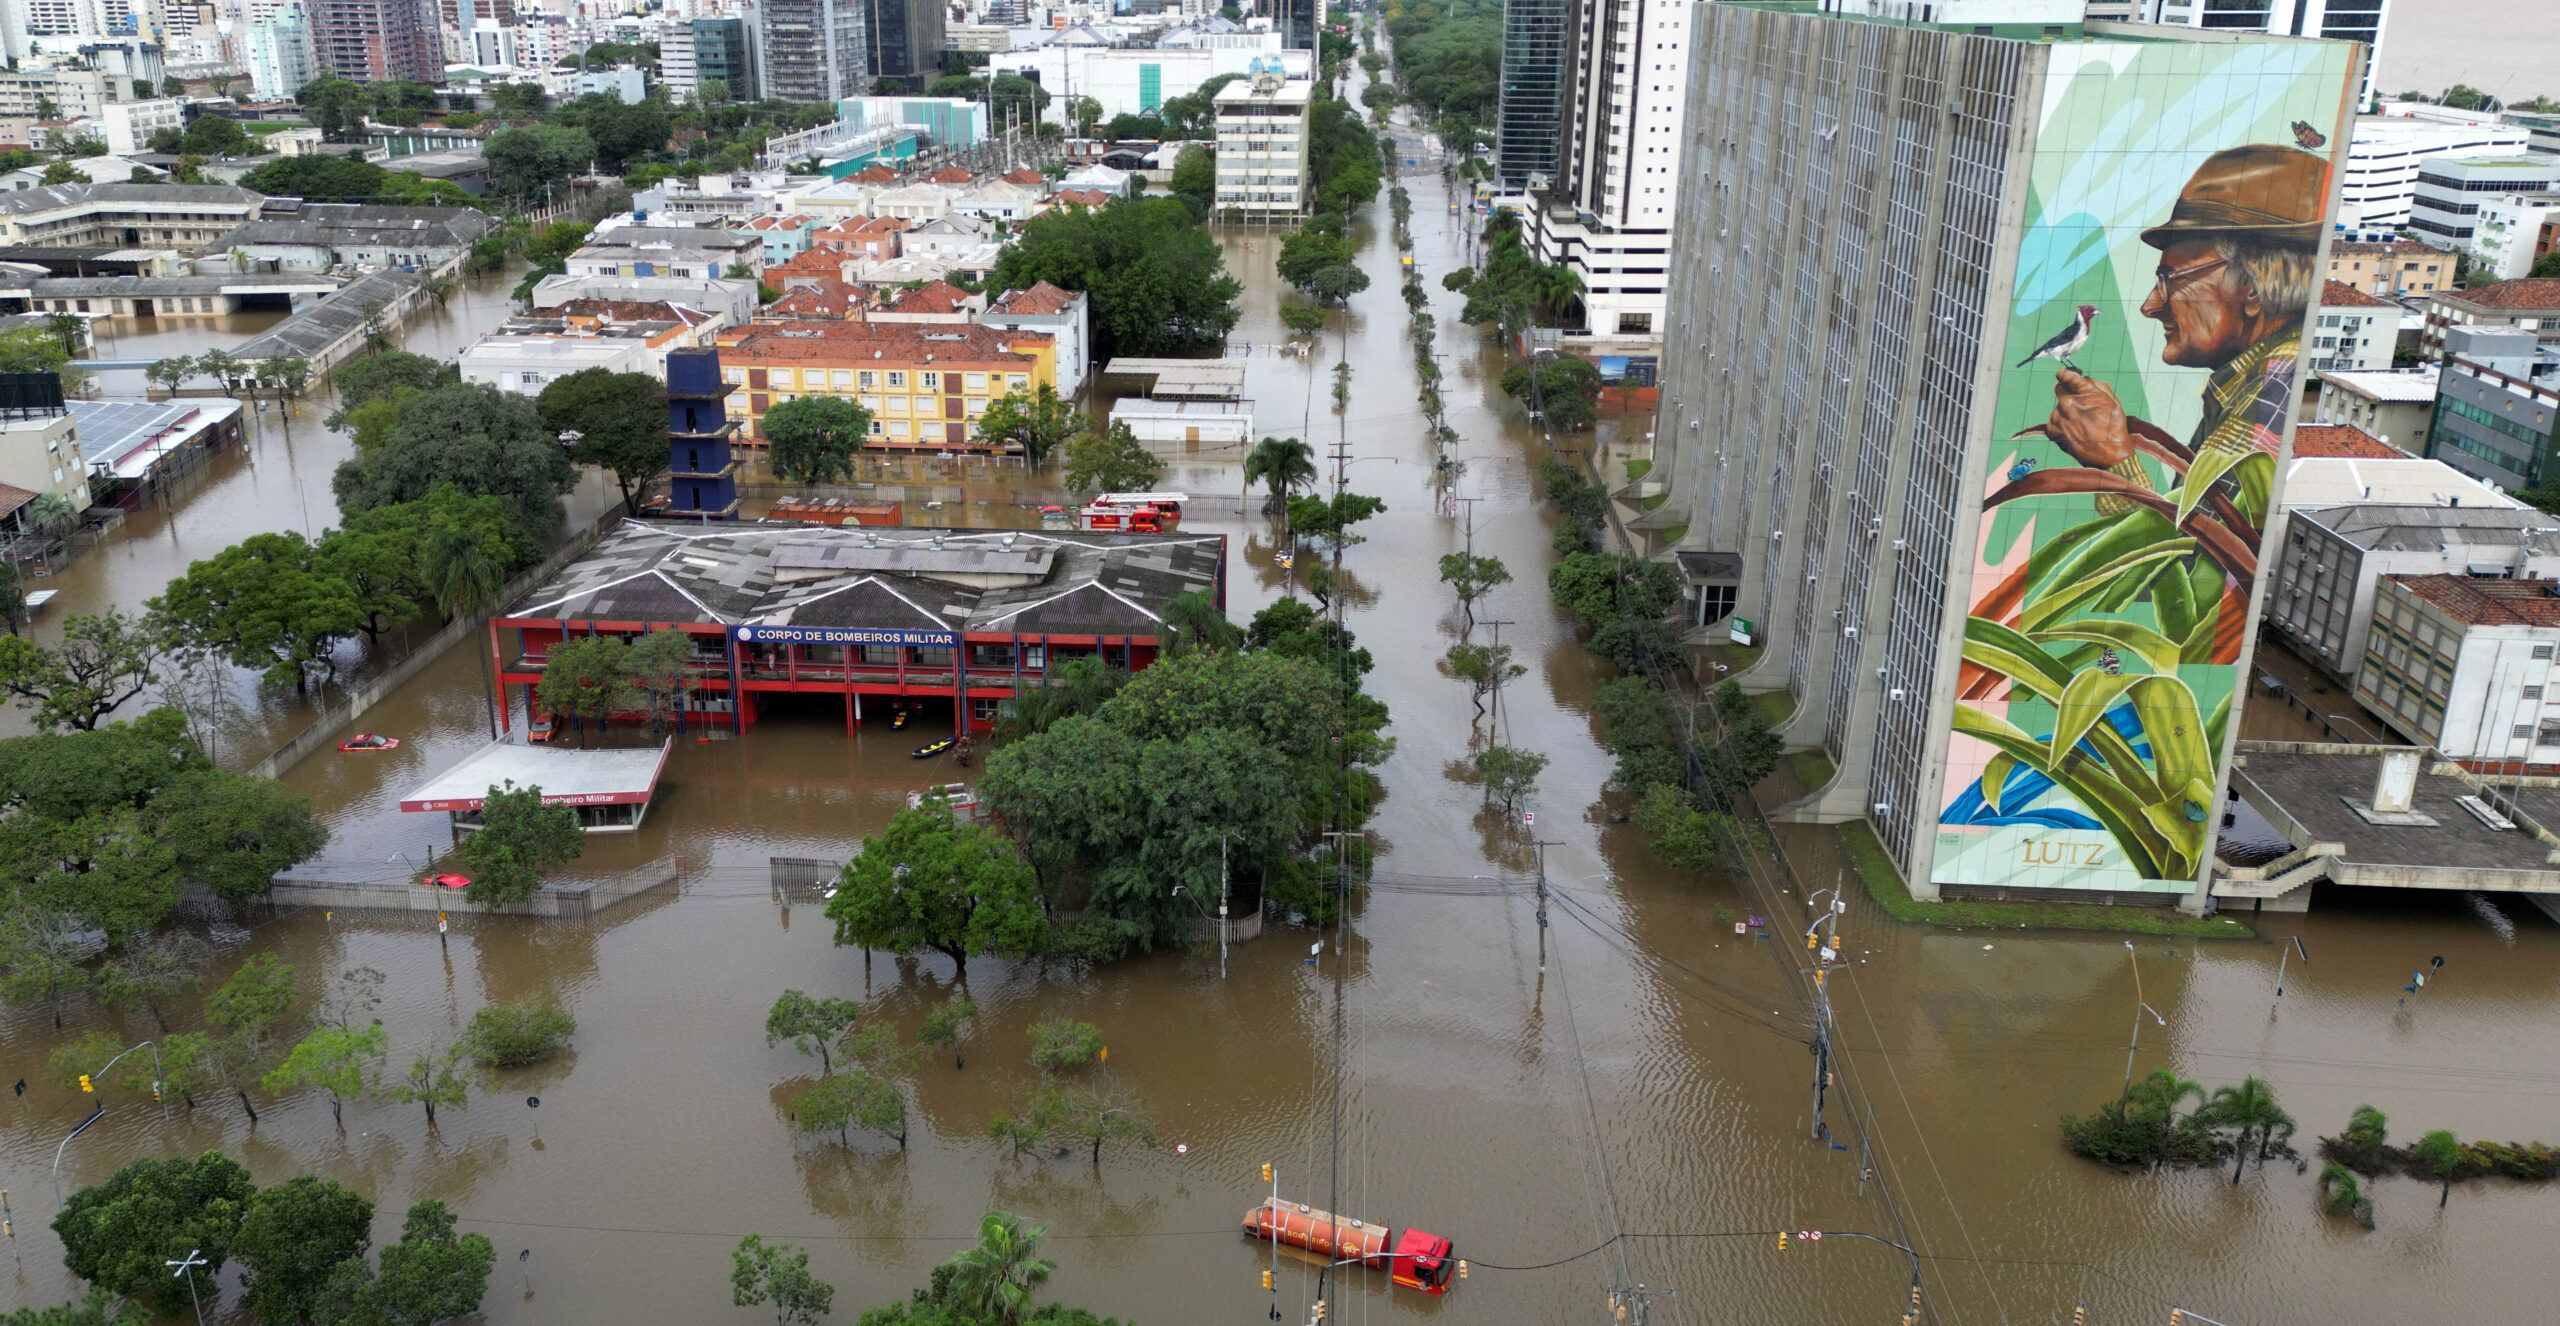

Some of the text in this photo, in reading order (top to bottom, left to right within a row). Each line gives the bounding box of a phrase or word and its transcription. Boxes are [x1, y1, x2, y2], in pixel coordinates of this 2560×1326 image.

[757, 630, 953, 644] CORPO DE BOMBEIROS MILITAR
[585, 794, 615, 803] Militar
[2022, 840, 2105, 866] LUTZ
[1287, 1230, 1333, 1248] BOMBEIRO
